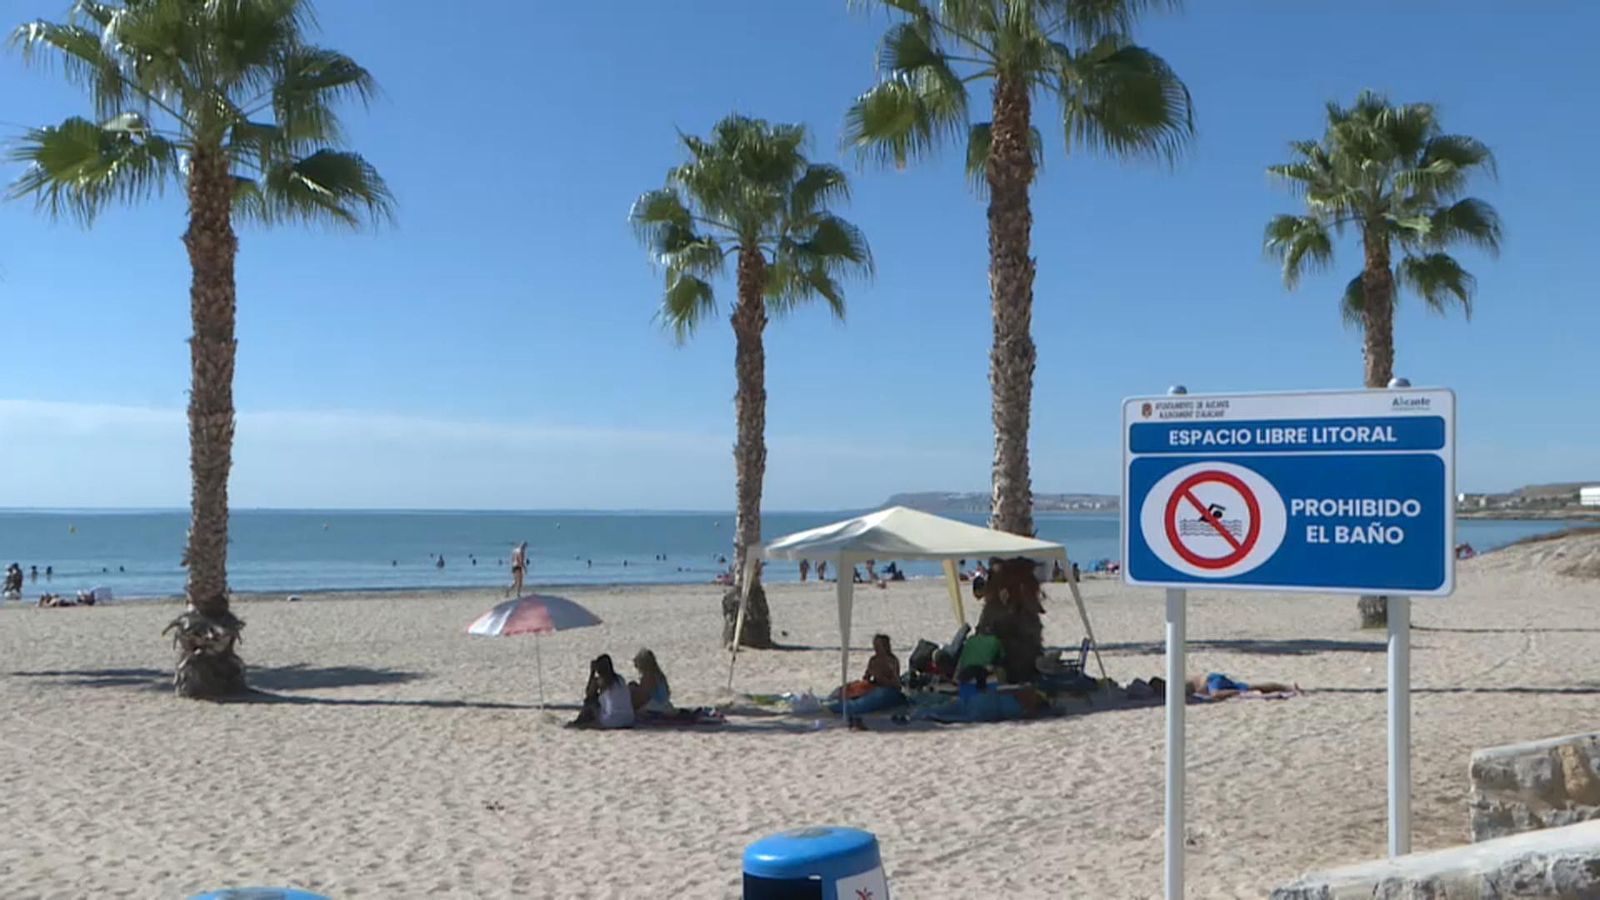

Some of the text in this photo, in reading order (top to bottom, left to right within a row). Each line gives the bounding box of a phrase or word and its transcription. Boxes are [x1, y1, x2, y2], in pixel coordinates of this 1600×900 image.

[1168, 426, 1397, 446] ESPACIO LIBRE LITORAL
[1290, 498, 1422, 517] PROHIBIDO
[1306, 521, 1405, 545] EL BAÑO
